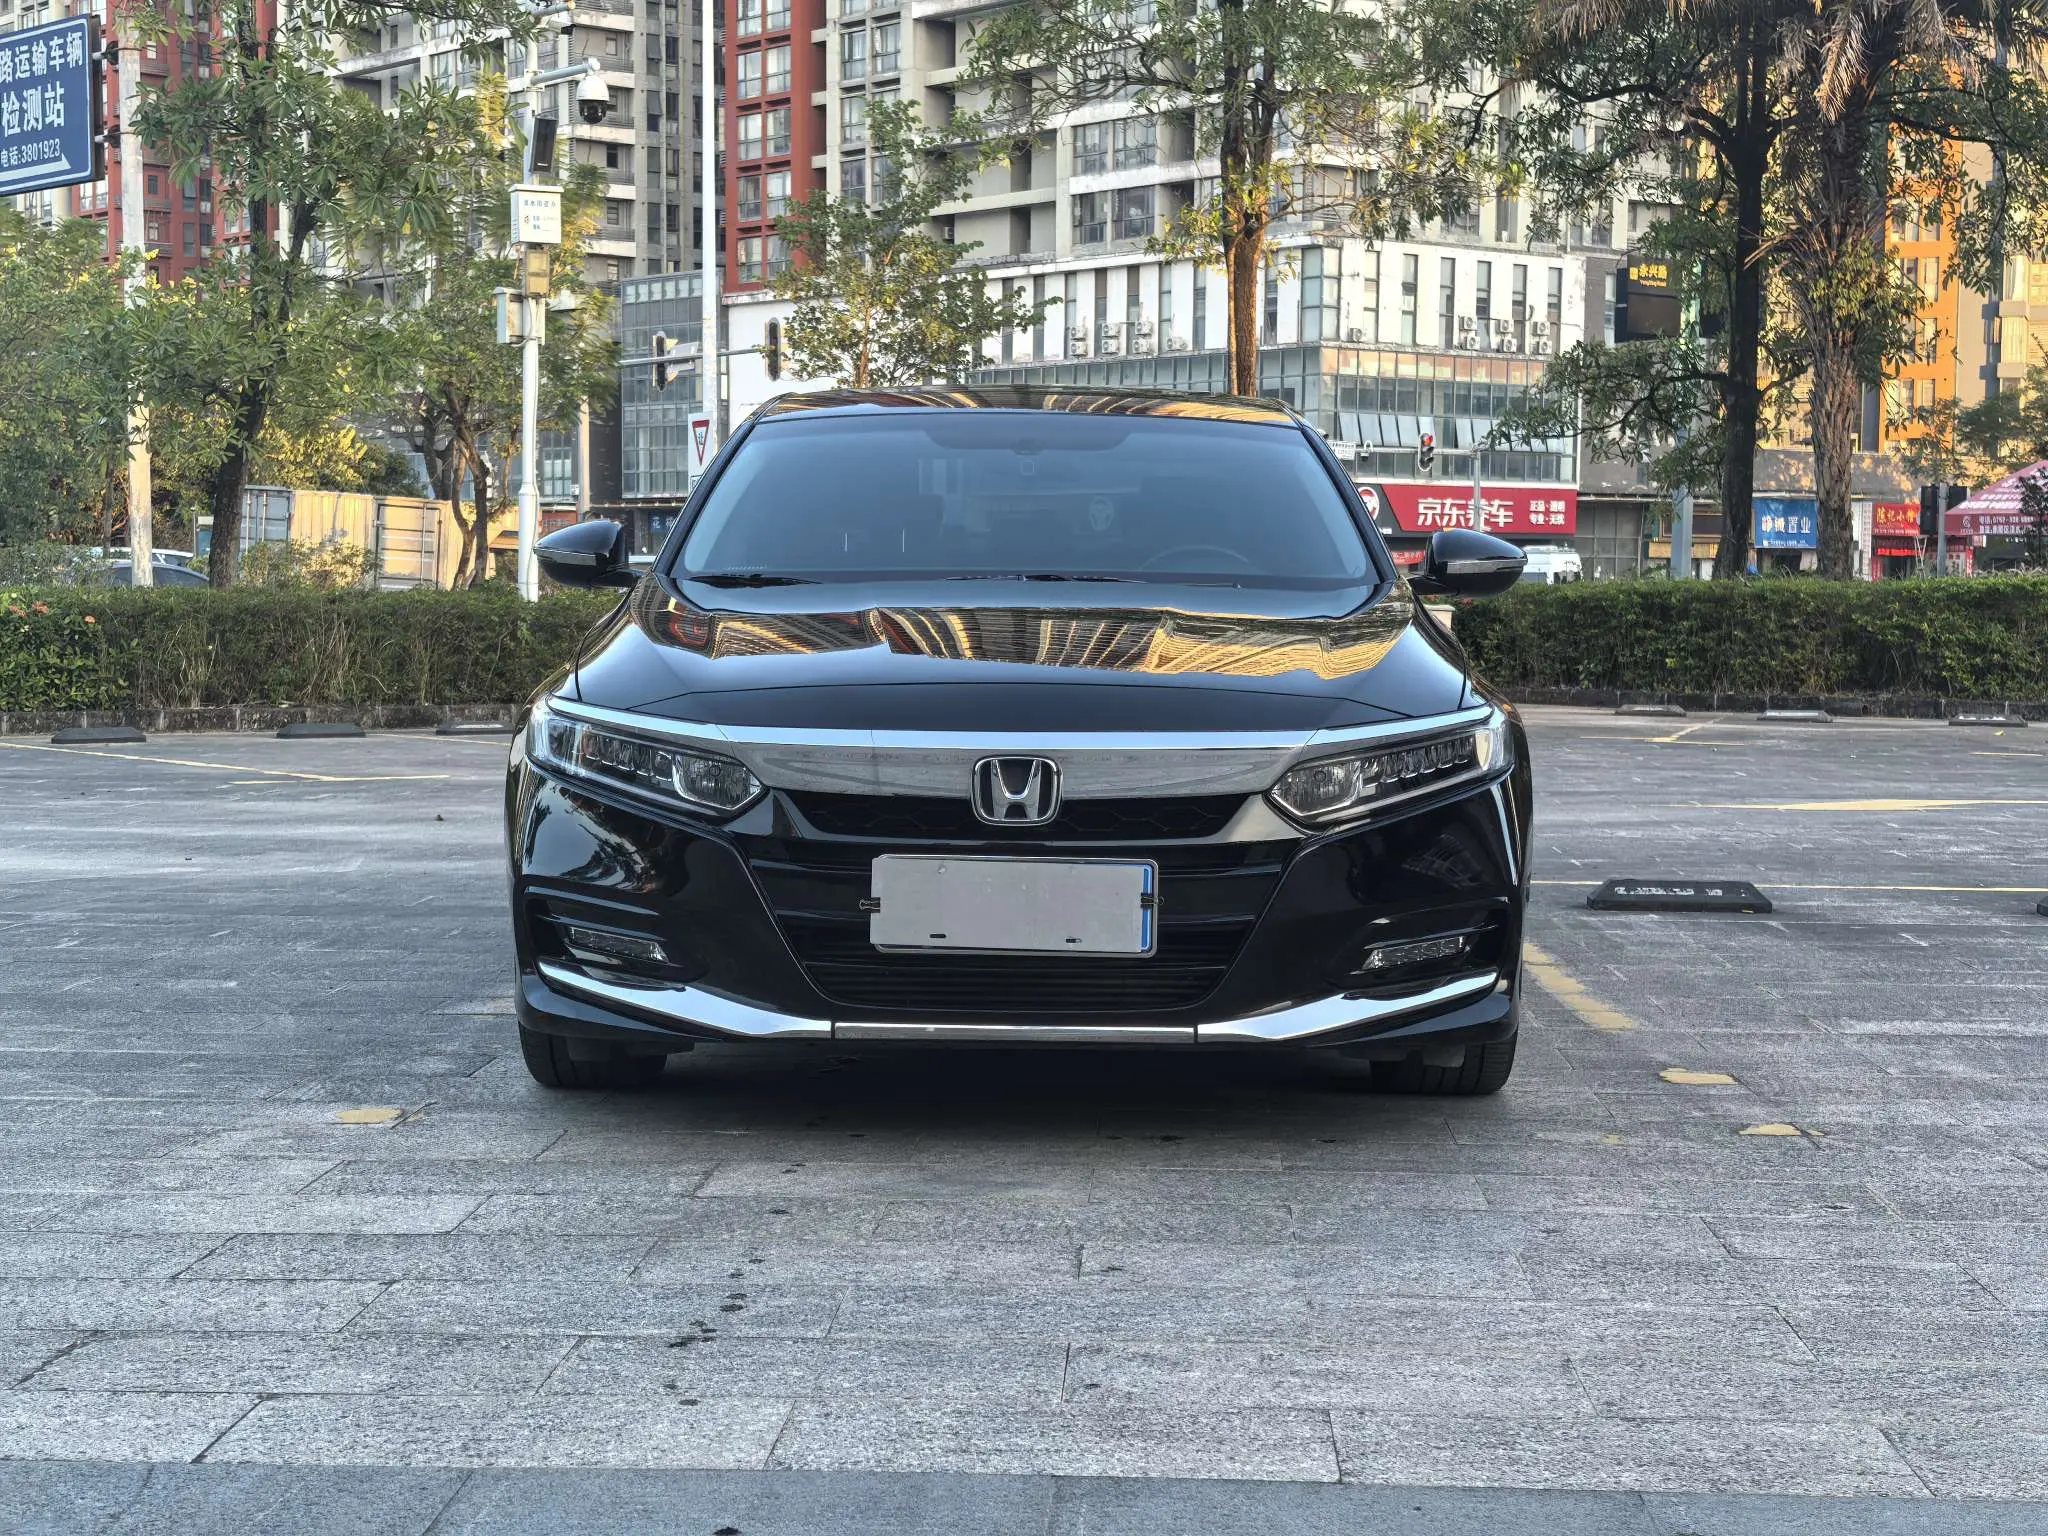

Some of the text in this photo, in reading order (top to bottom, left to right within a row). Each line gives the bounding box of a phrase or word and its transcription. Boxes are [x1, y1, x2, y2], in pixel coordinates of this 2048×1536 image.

[0, 31, 82, 83] 路运输车辆
[1, 81, 64, 137] 检测站
[1417, 498, 1513, 531] 京东养车
